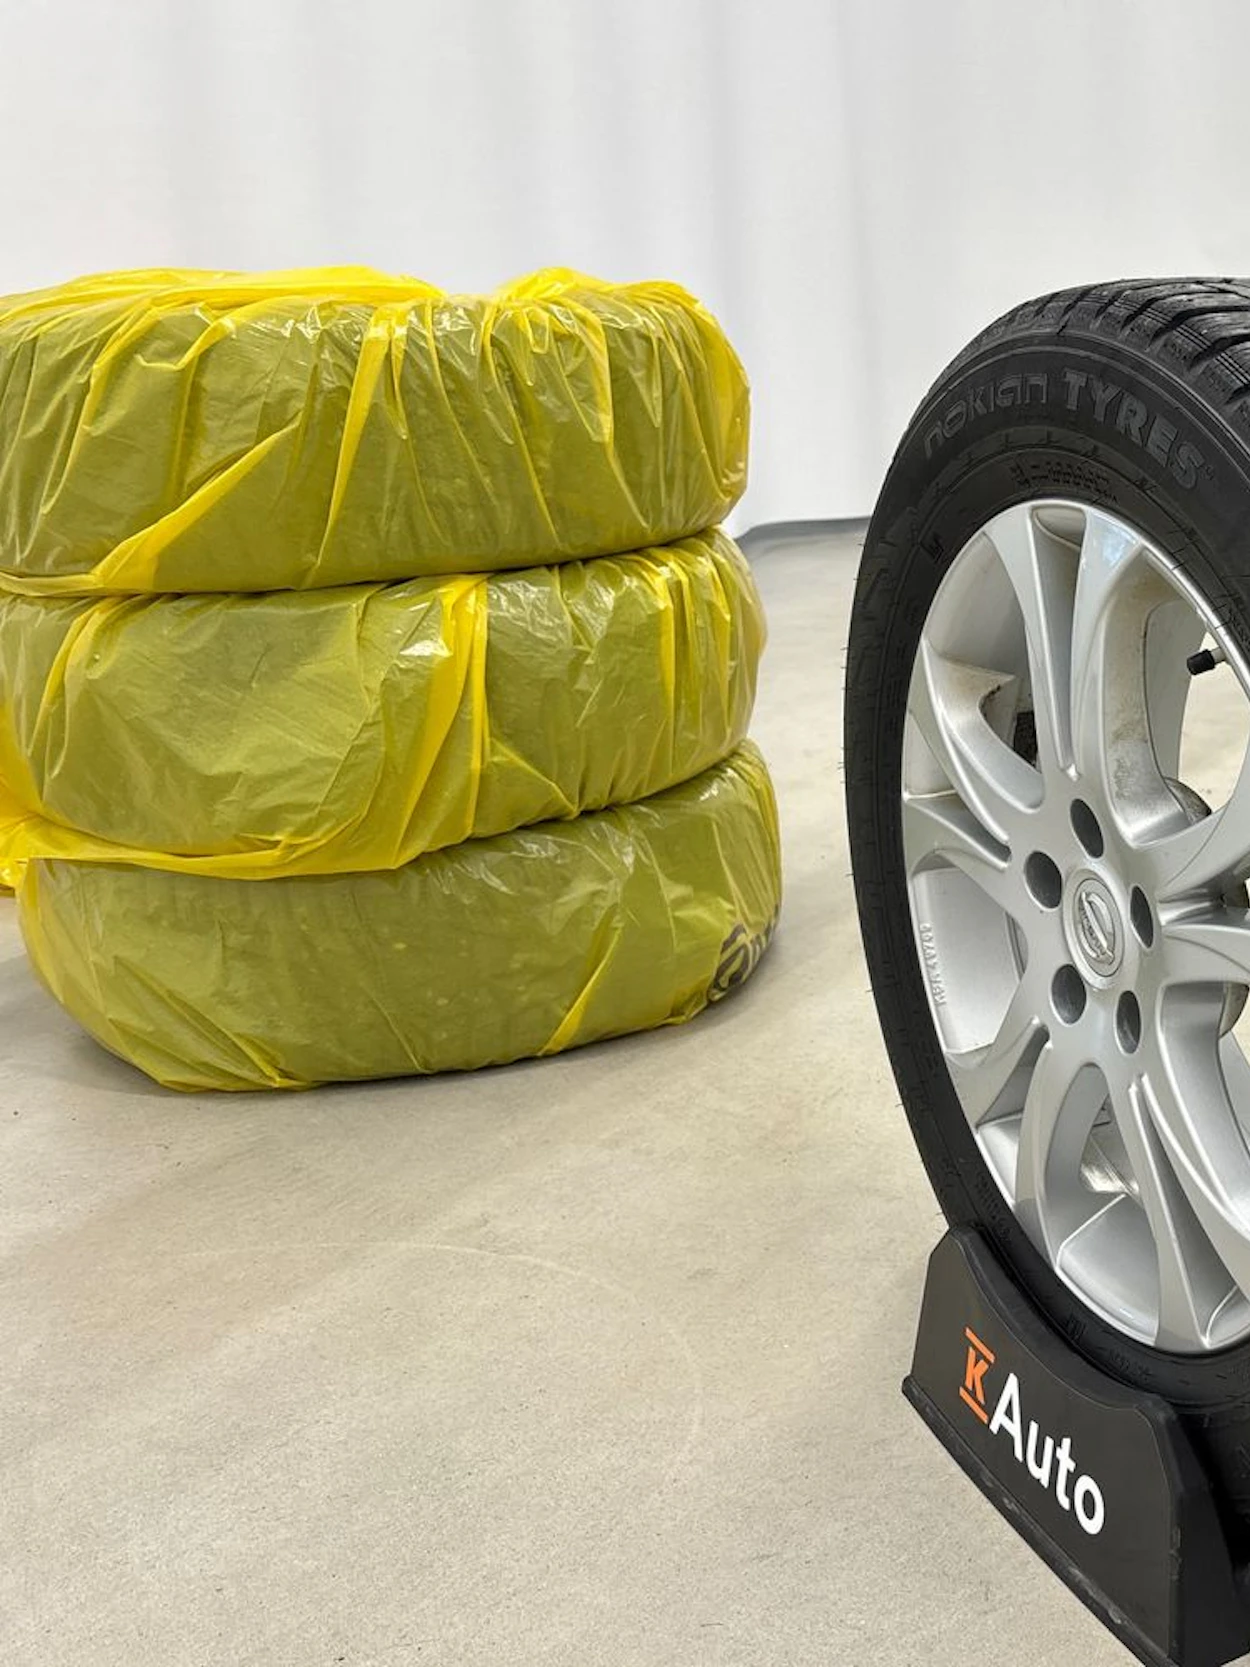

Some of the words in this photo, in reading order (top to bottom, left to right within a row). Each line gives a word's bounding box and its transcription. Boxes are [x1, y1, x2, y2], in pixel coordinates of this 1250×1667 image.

[923, 373, 1048, 457] nokian
[1063, 368, 1205, 489] TYRES
[989, 1373, 1105, 1534] Auto
